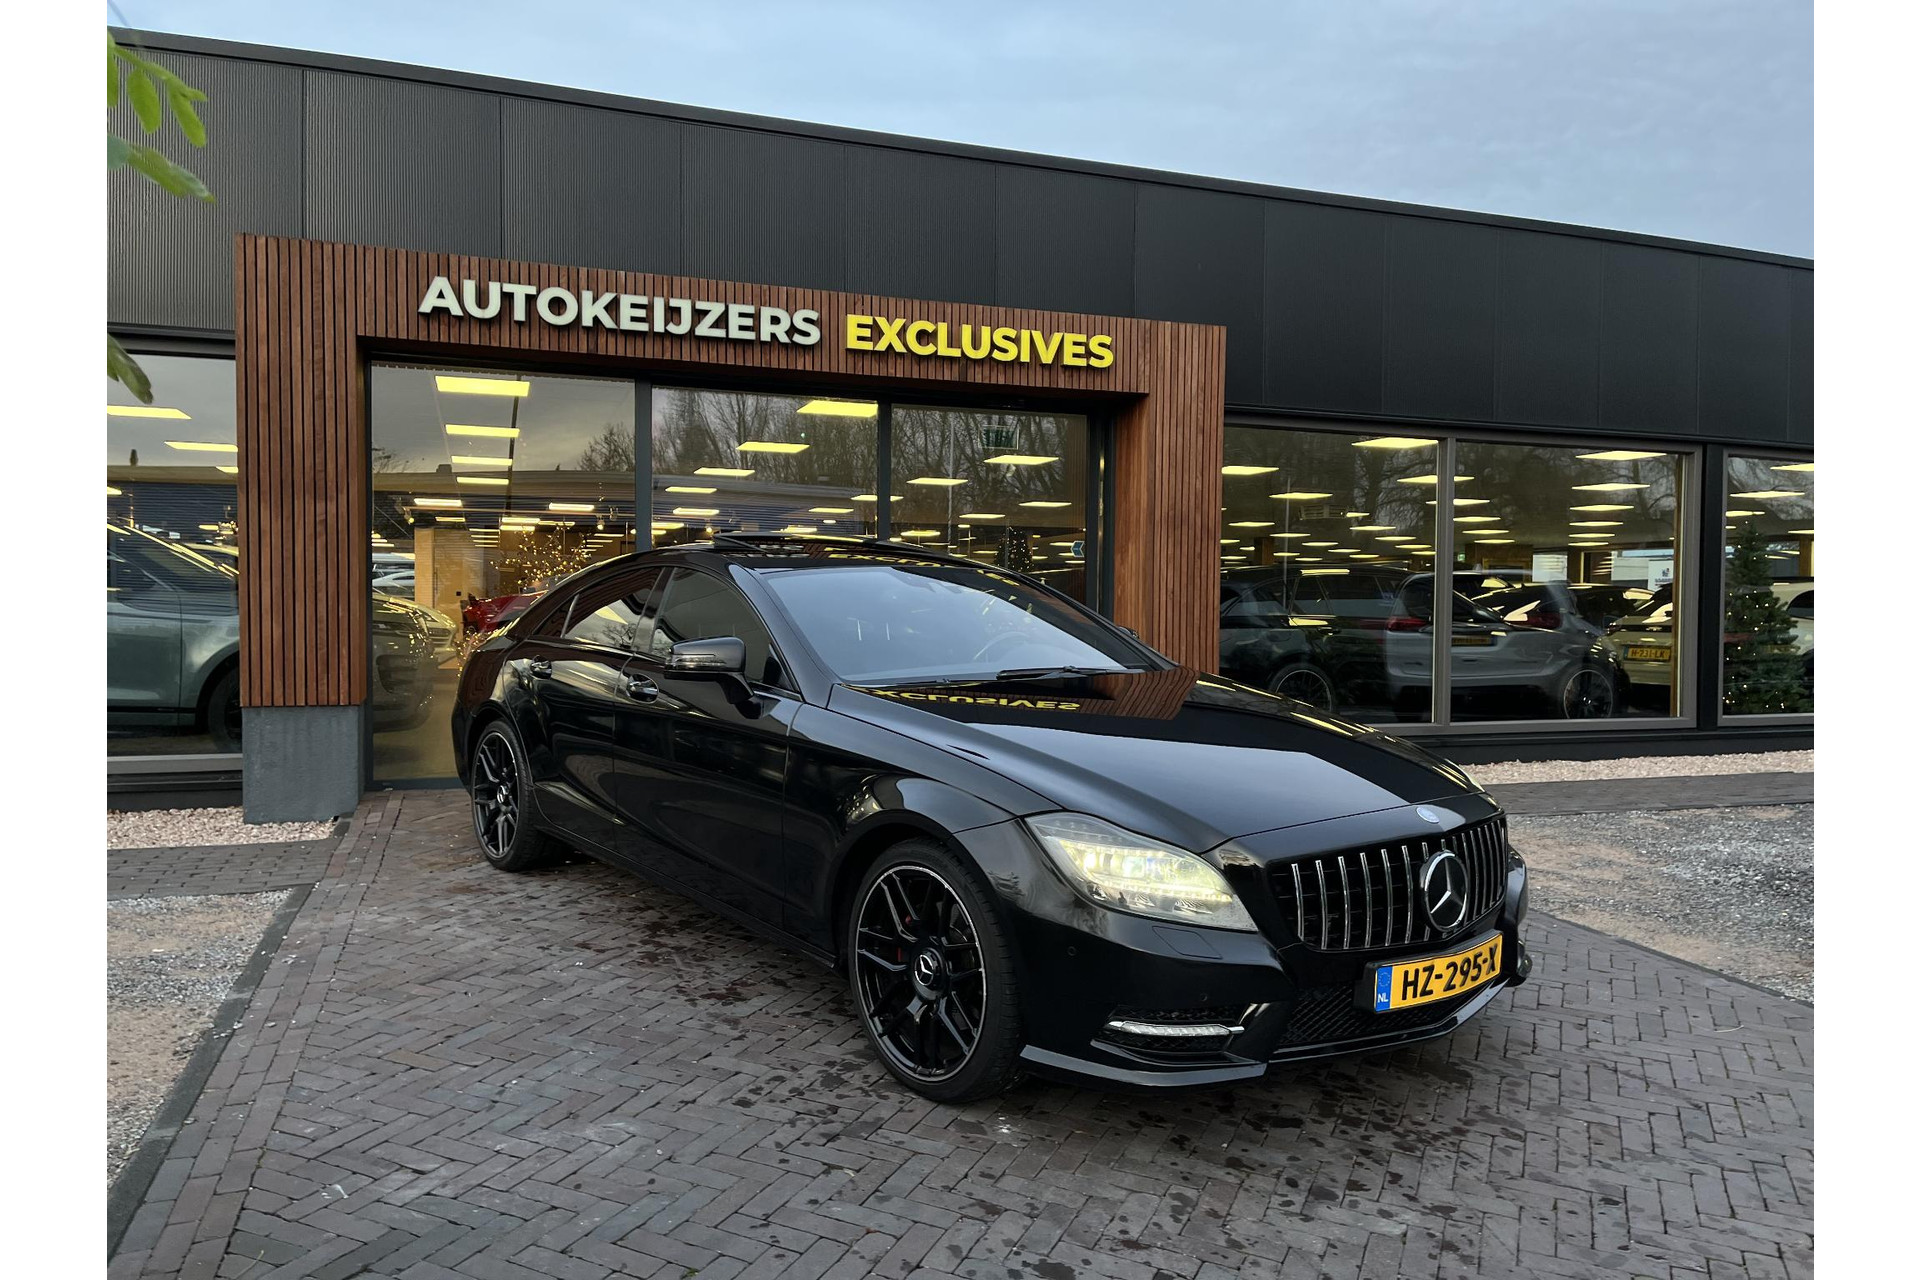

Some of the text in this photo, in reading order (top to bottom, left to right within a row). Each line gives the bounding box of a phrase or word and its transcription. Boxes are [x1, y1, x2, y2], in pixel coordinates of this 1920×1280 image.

[418, 276, 1114, 368] AUTOKEIJZERS EXCLUSIVES
[1378, 993, 1389, 1002] NL
[1402, 943, 1498, 1000] HZ-295-X
